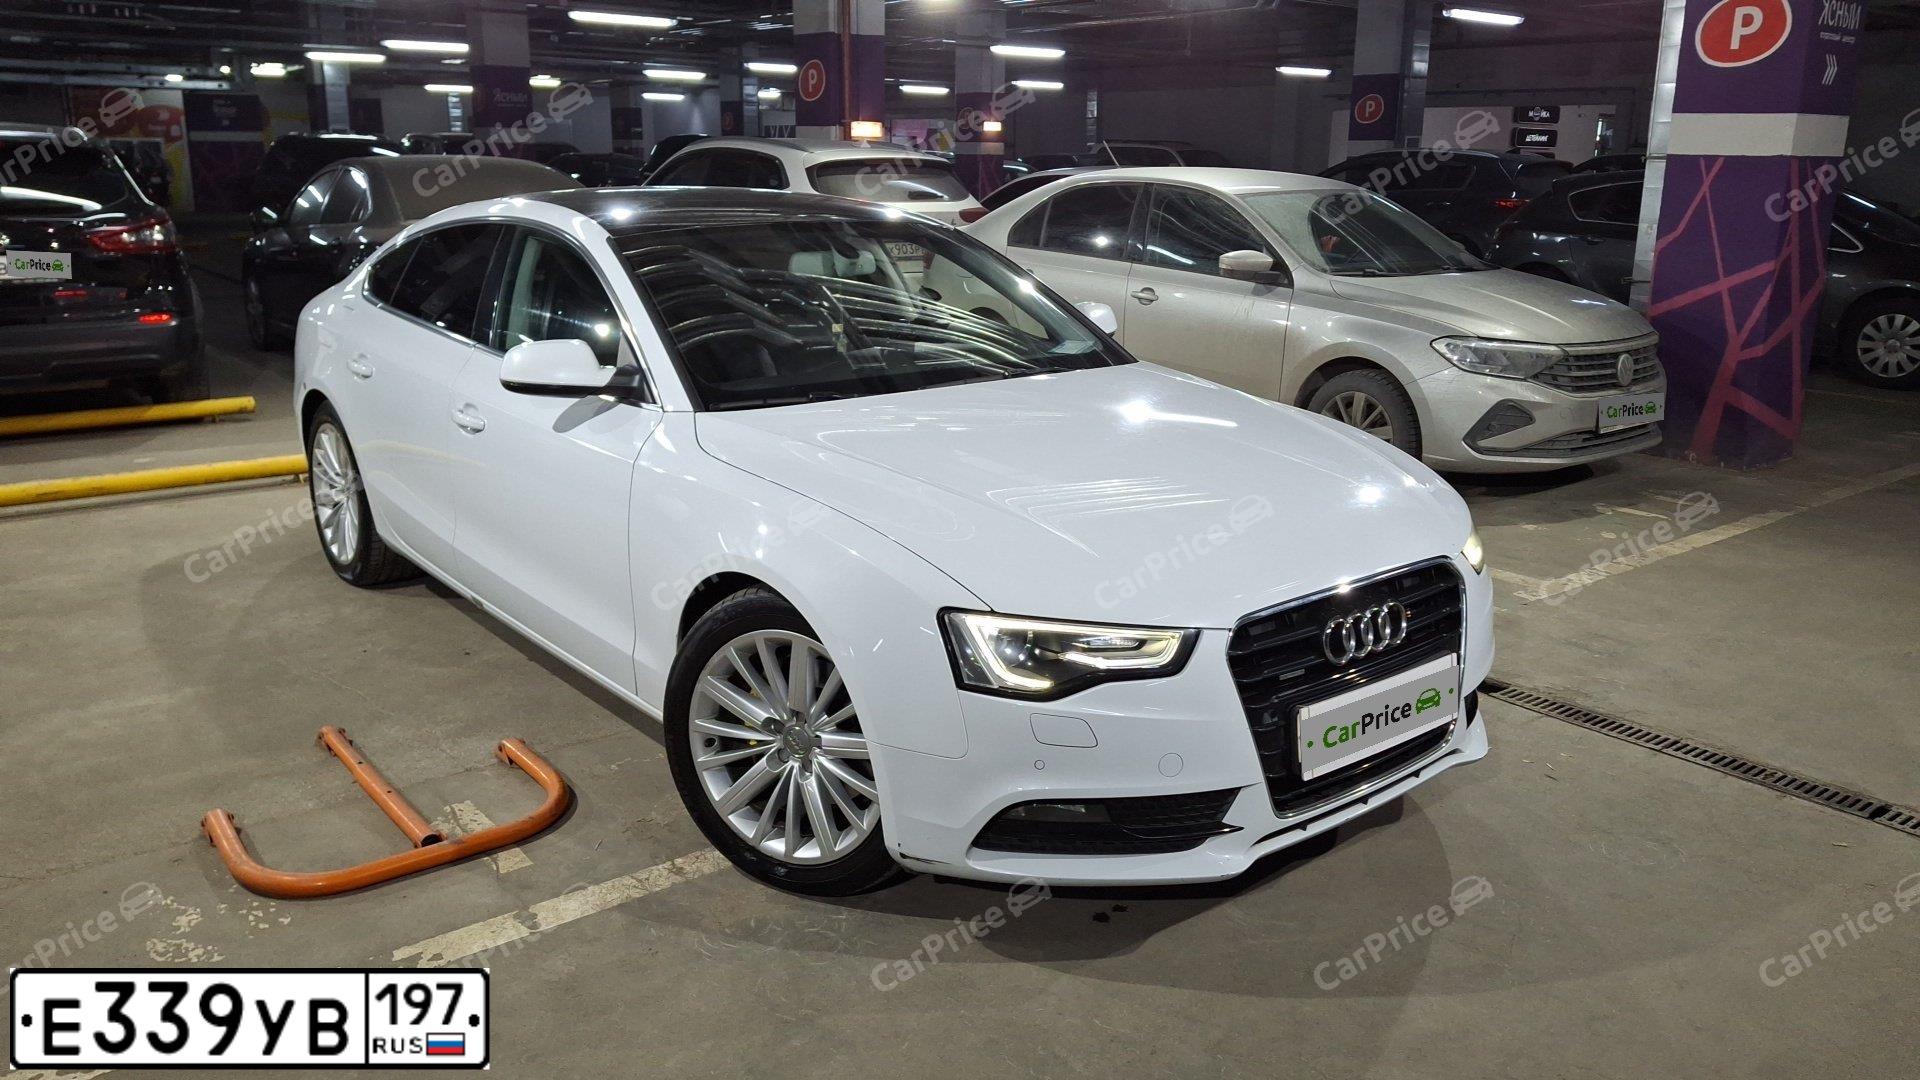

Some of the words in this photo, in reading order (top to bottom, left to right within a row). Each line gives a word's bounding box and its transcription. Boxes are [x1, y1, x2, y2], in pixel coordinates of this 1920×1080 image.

[1730, 5, 1764, 50] P
[808, 68, 818, 93] P
[1365, 100, 1376, 118] P
